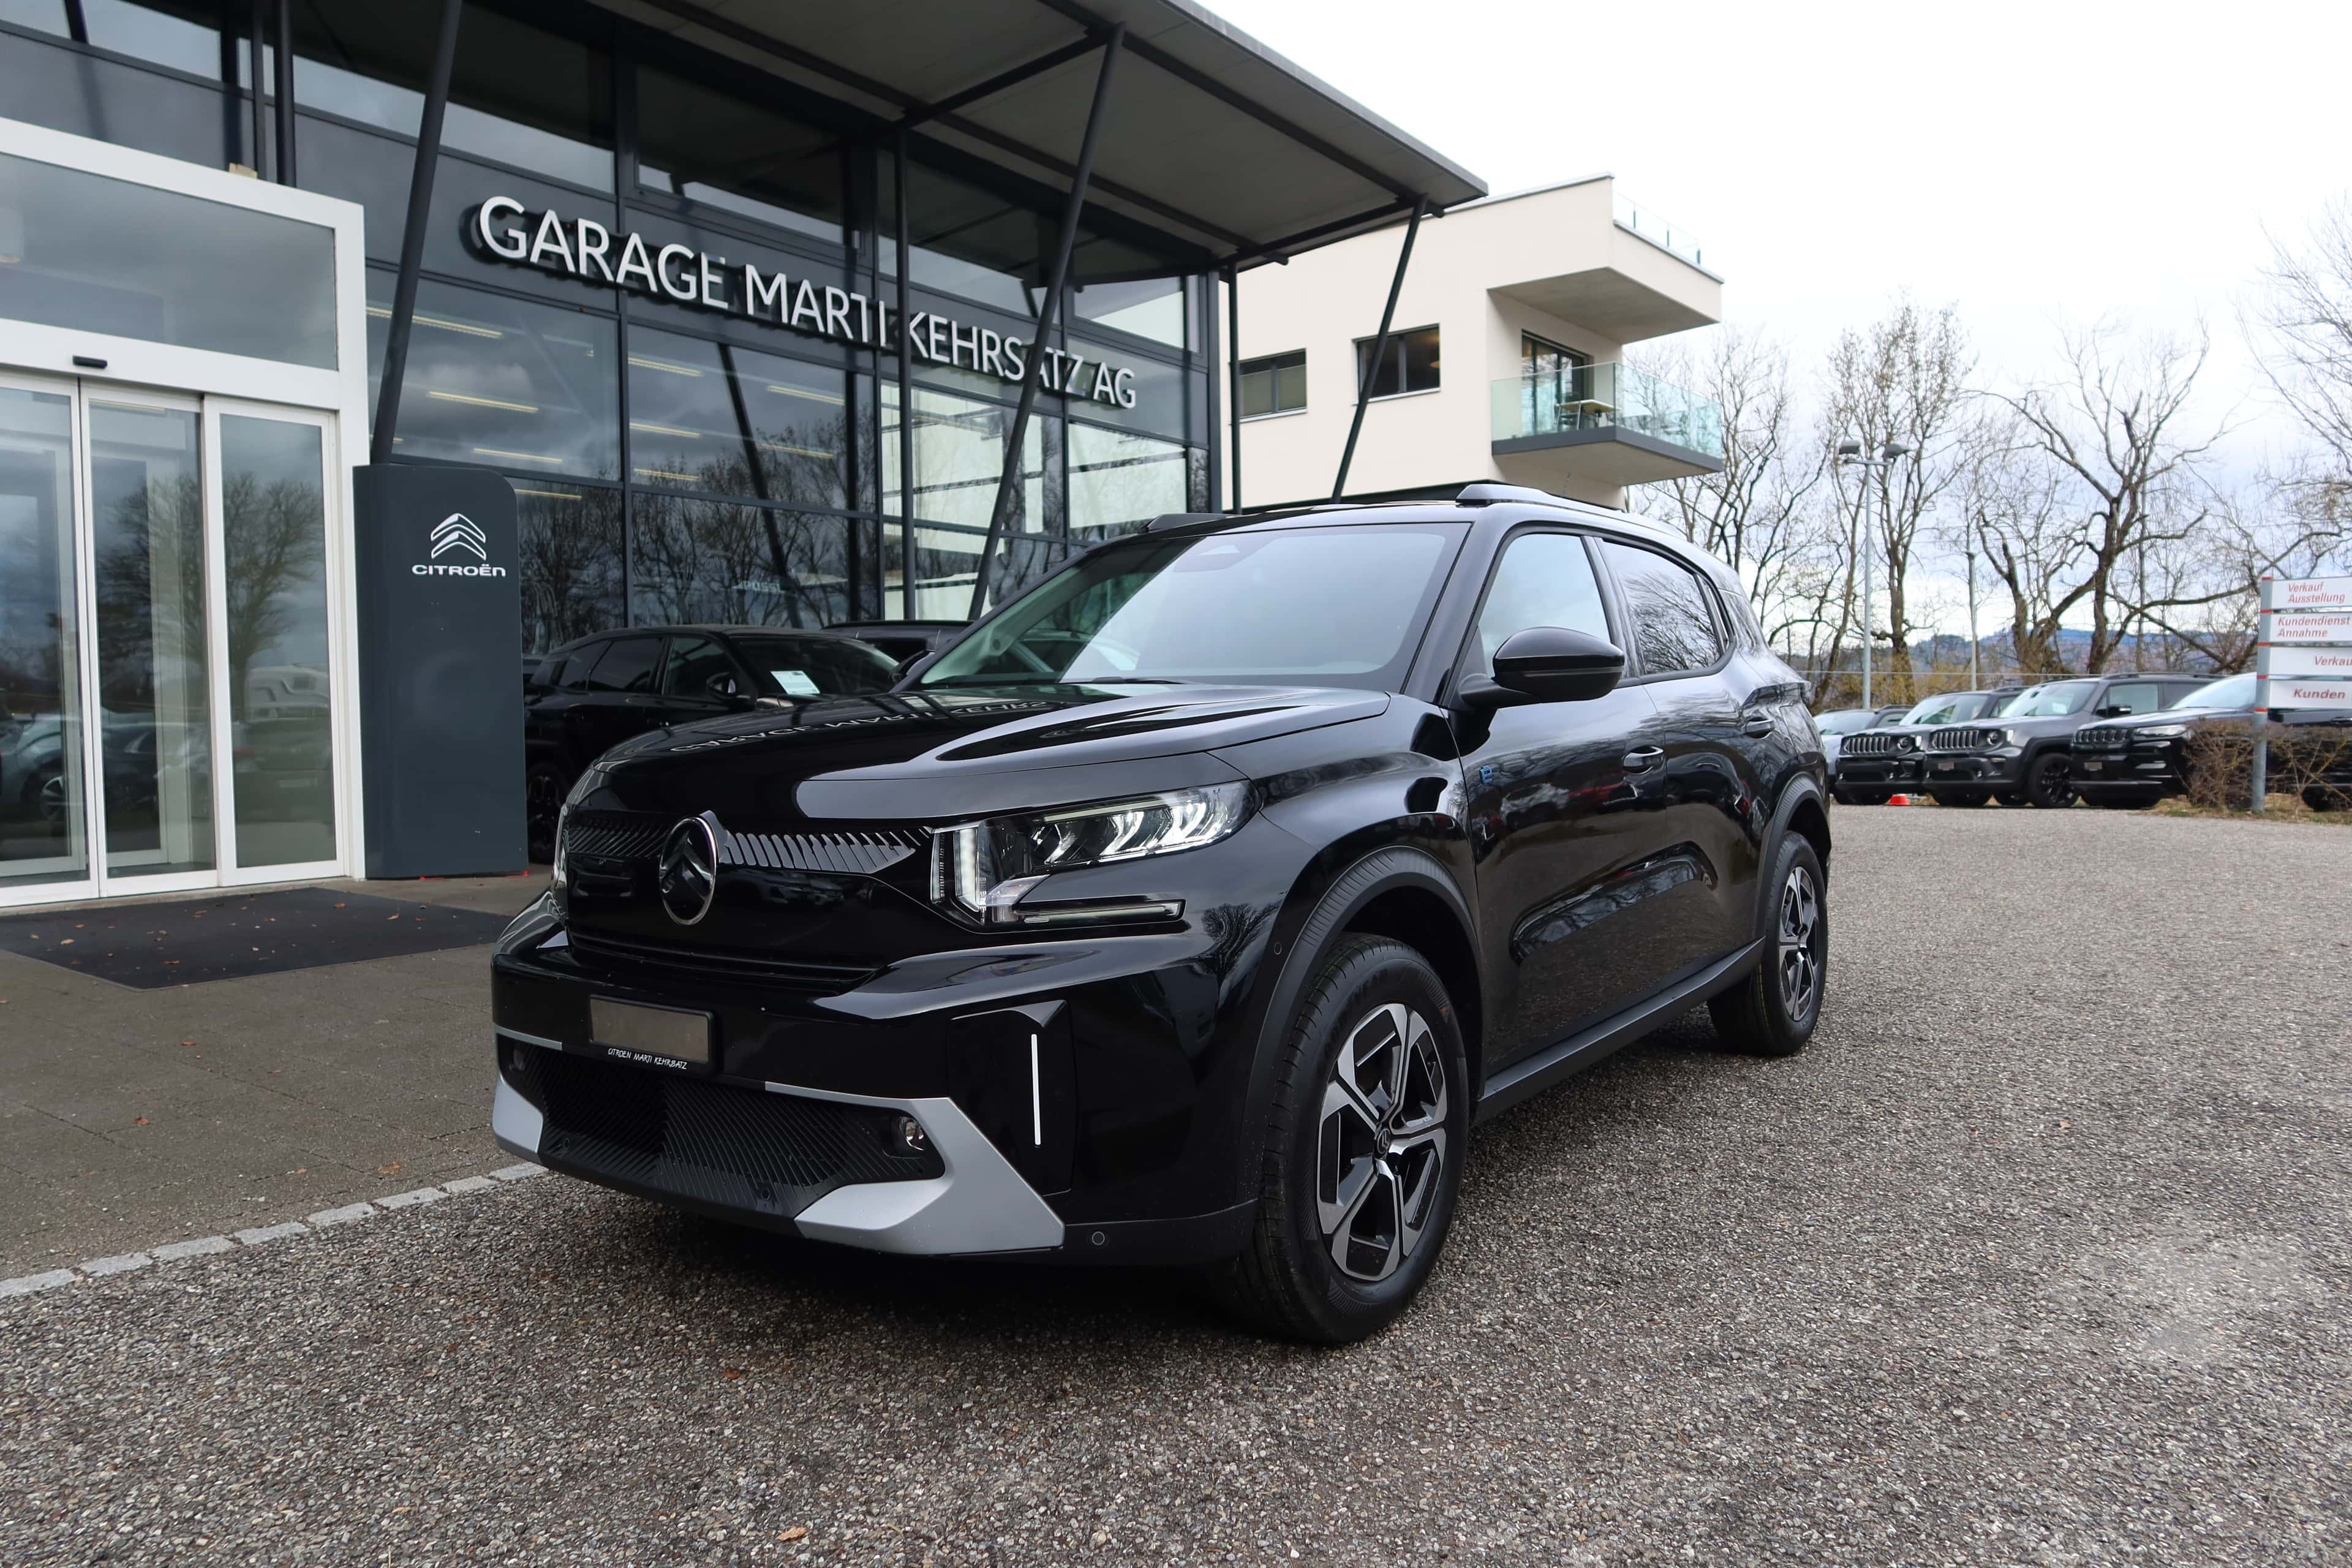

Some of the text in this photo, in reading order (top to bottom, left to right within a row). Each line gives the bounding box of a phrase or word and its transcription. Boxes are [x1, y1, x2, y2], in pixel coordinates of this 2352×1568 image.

[480, 196, 1136, 409] GARAGE MARTI KEHRSTZ AG
[2288, 581, 2323, 592] Verkauf
[2288, 593, 2345, 603] Ausstellung
[2278, 616, 2350, 626] Kundendienst
[2278, 628, 2328, 638] Annahme
[2293, 688, 2346, 699] Kunden
[633, 1053, 652, 1063] MARTI
[654, 1057, 687, 1069] KEHRSATZ
